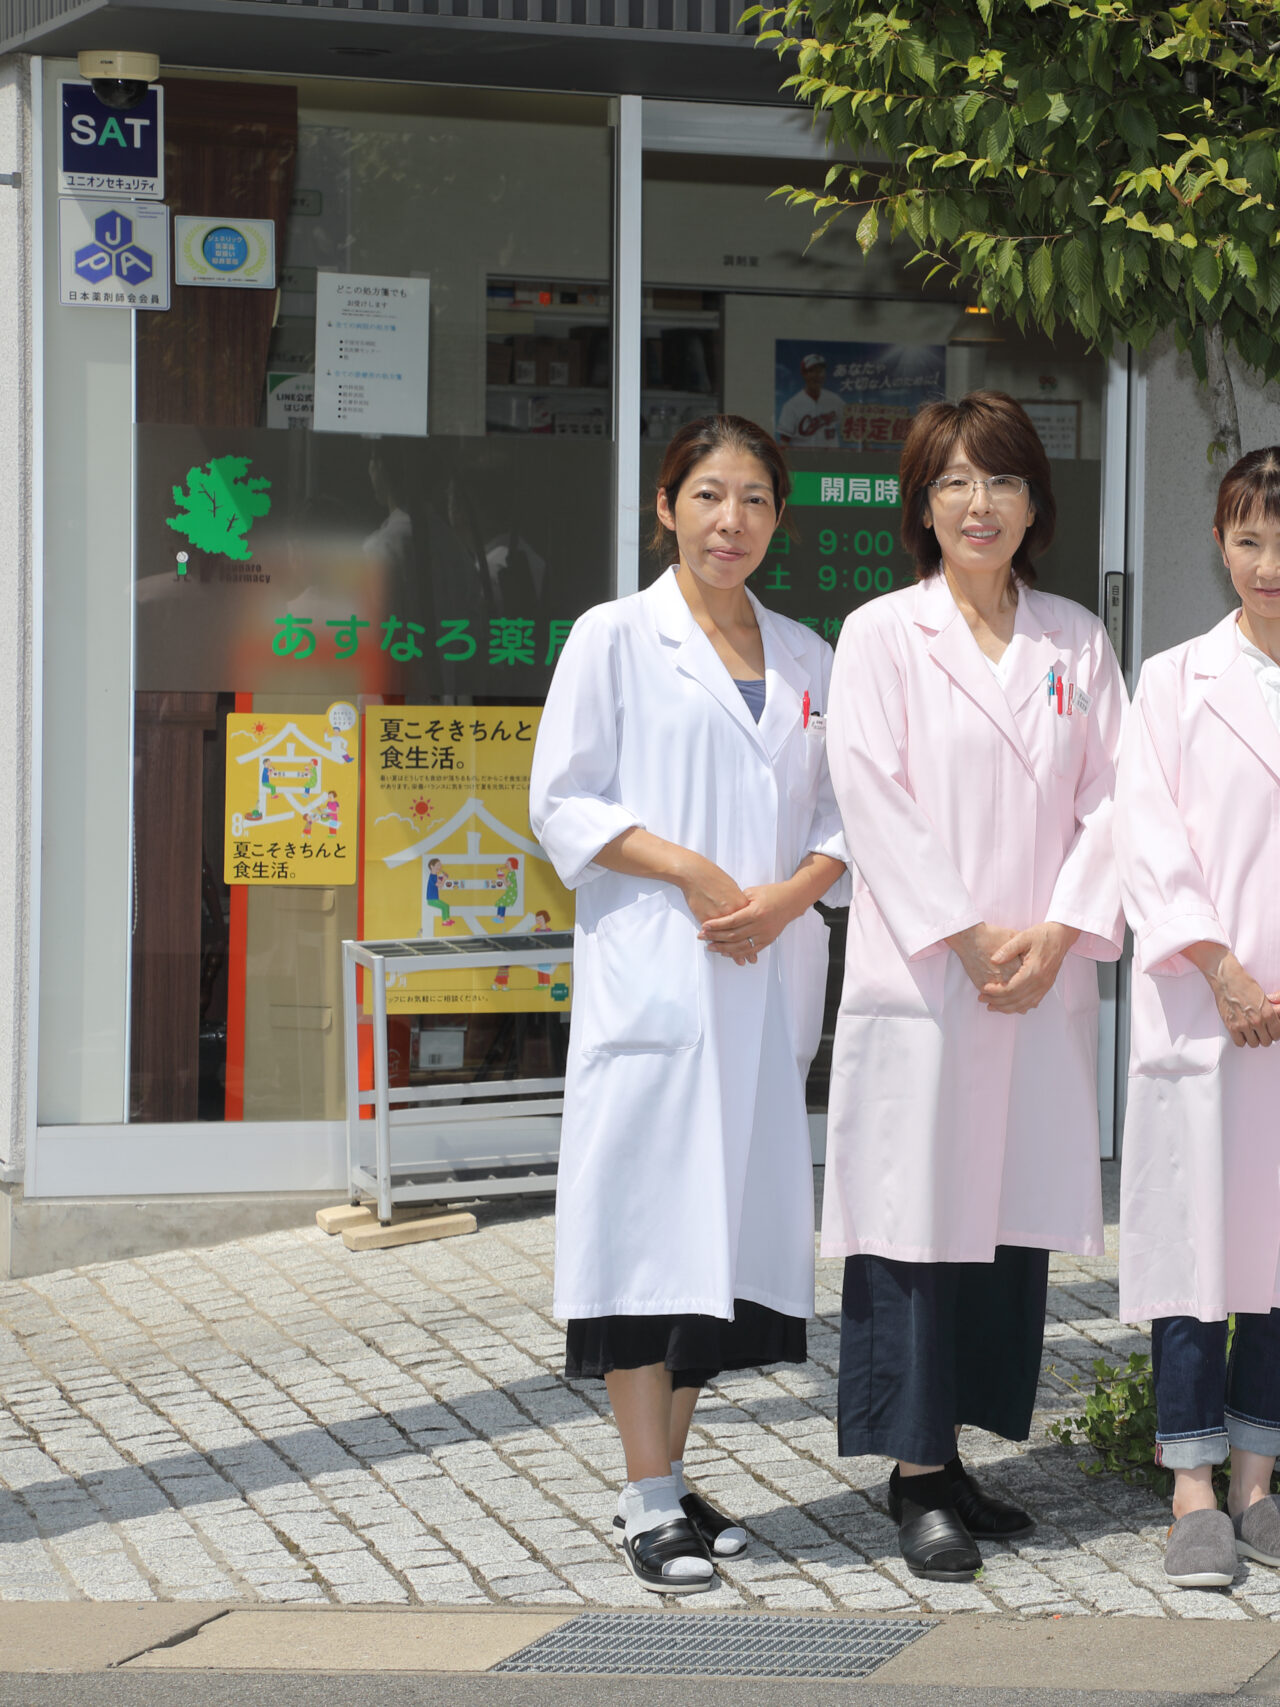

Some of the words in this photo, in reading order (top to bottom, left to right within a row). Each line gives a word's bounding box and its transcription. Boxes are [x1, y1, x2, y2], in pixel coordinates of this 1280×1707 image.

[70, 114, 150, 148] SAT
[67, 176, 155, 191] ユニオンセキュリティ
[69, 291, 160, 304] 日本薬剤師会会員
[336, 285, 408, 298] どこの処方箋でも
[832, 362, 887, 378] あなたや
[818, 529, 894, 556] 9:00
[818, 565, 893, 592] 9:00
[380, 718, 532, 742] 夏こそきちんと
[380, 745, 464, 769] 食生活。
[233, 841, 346, 859] 夏こそきちんと
[233, 861, 296, 879] 食生活。
